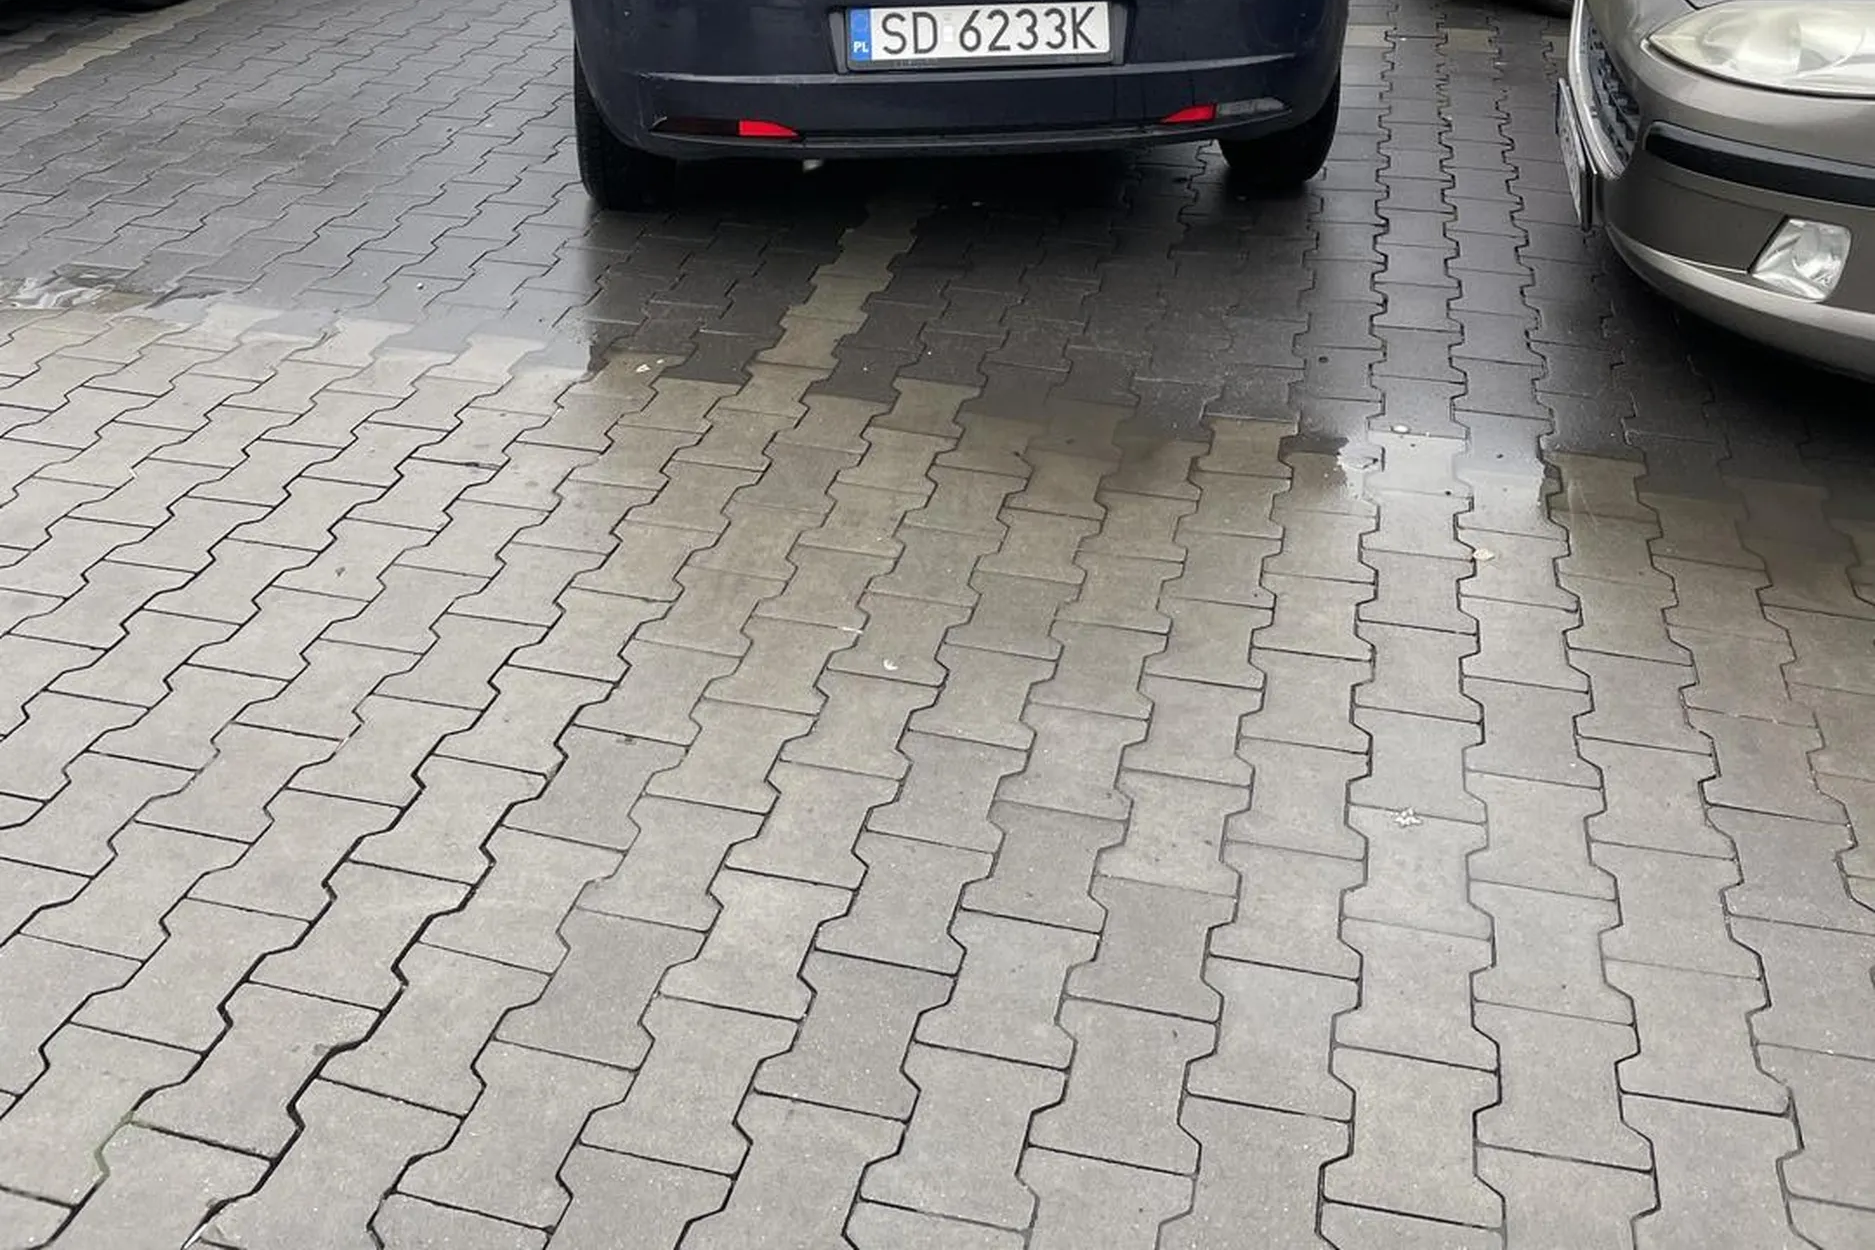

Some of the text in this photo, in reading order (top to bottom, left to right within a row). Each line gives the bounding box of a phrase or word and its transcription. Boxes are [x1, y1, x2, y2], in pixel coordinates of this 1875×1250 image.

[881, 6, 1098, 55] SD 6233K
[853, 40, 869, 54] PL
